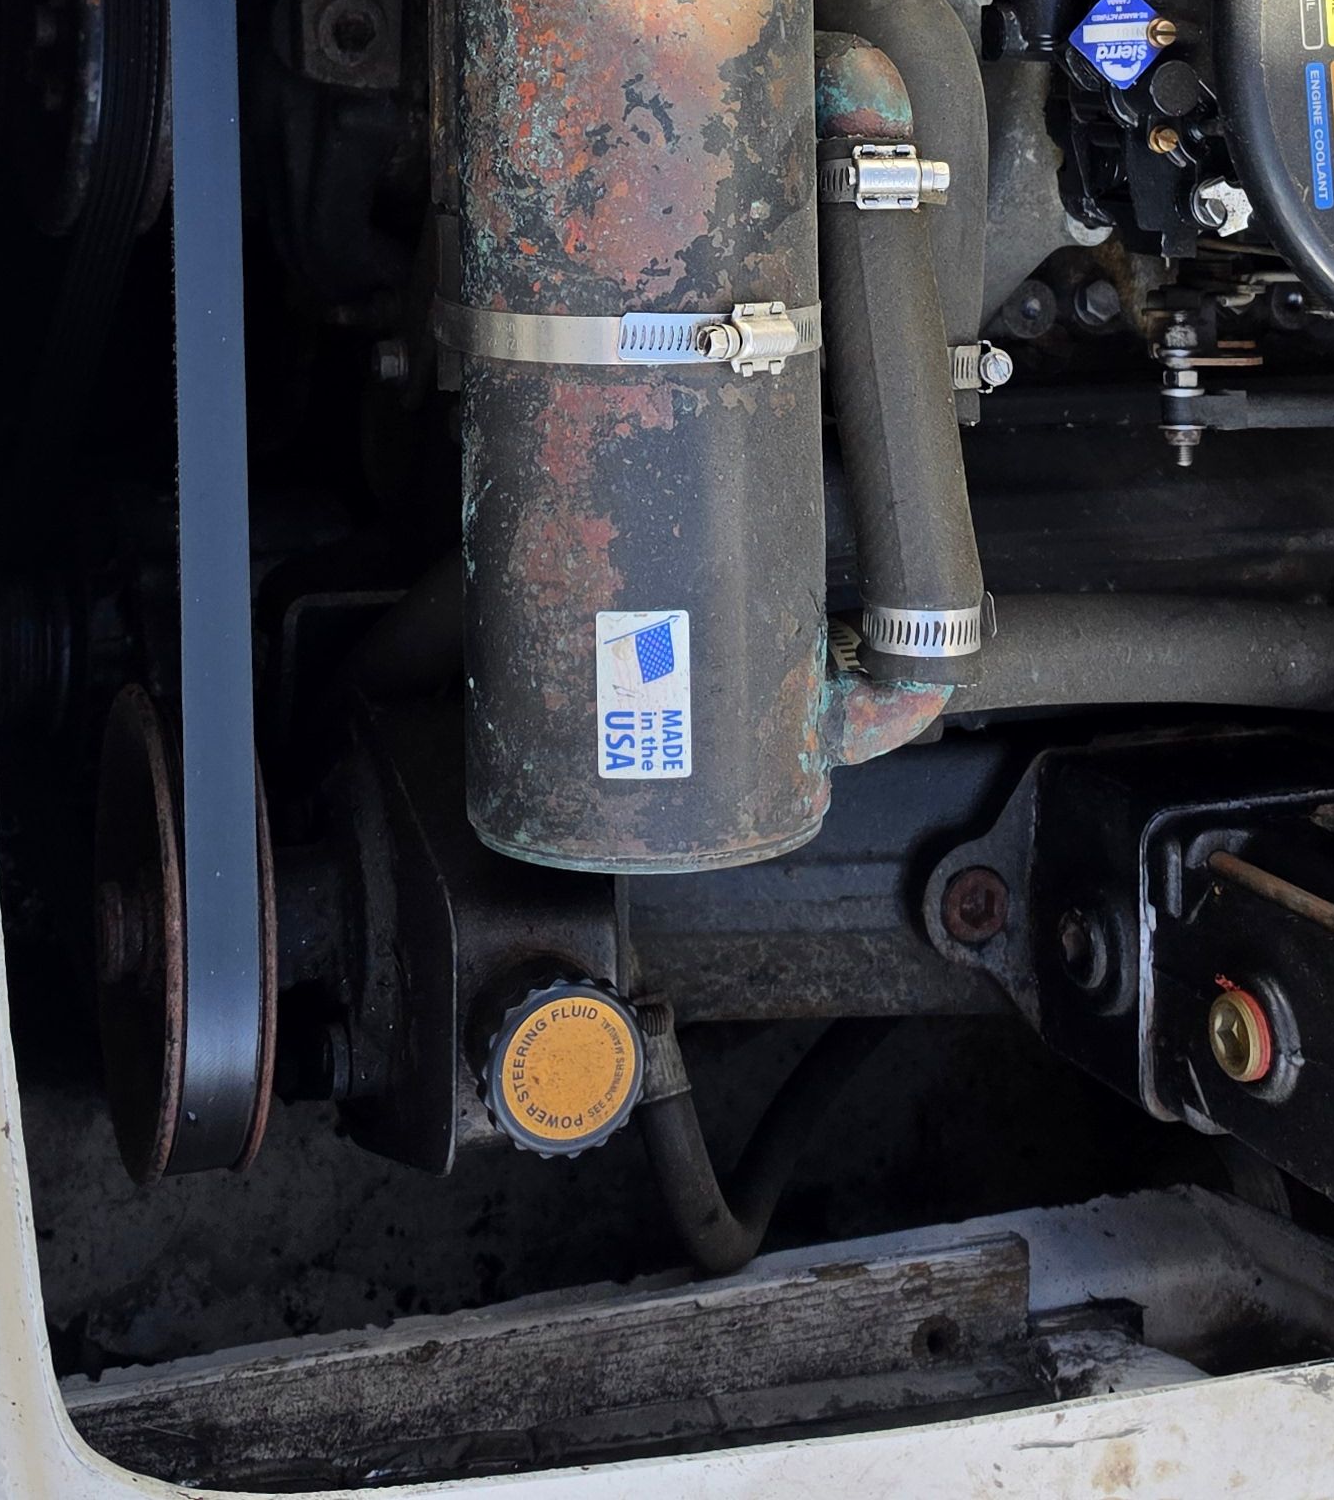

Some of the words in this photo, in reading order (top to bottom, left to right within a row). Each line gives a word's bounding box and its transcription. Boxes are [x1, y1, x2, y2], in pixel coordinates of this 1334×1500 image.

[1309, 69, 1323, 126] ENGINE
[1313, 129, 1329, 201] COOLANT
[605, 710, 635, 771] USA
[641, 711, 657, 731] in
[662, 709, 683, 771] MADE
[641, 736, 658, 771] the
[551, 1004, 598, 1022] FLUID
[600, 1016, 625, 1055] MANUAL
[512, 1018, 548, 1104] STEERING
[604, 1057, 625, 1102] OWNERS
[526, 1103, 584, 1130] POWER
[588, 1100, 606, 1118] SEE
